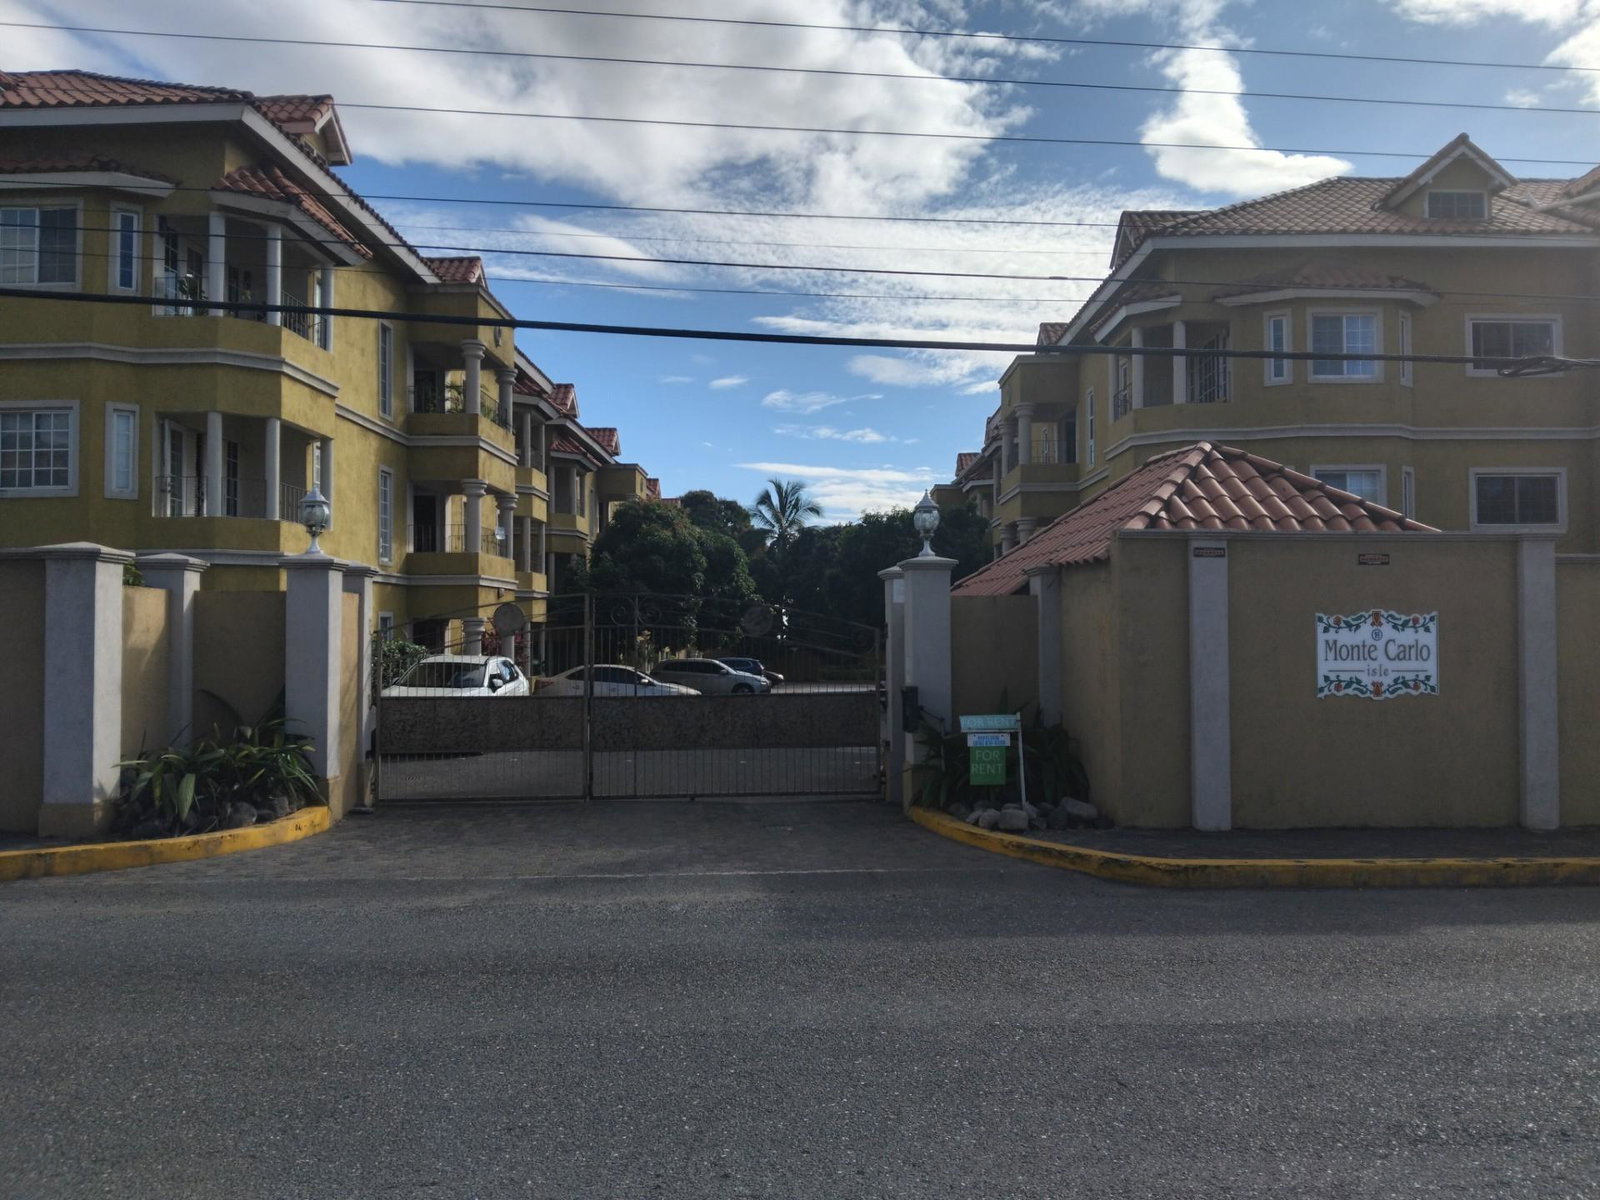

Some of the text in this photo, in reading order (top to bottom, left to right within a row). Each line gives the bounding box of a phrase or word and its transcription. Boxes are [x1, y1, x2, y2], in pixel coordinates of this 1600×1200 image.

[1323, 639, 1431, 661] Monte Carlo
[1367, 664, 1389, 677] isle
[975, 750, 1000, 761] FOR
[971, 763, 1002, 775] RENT
